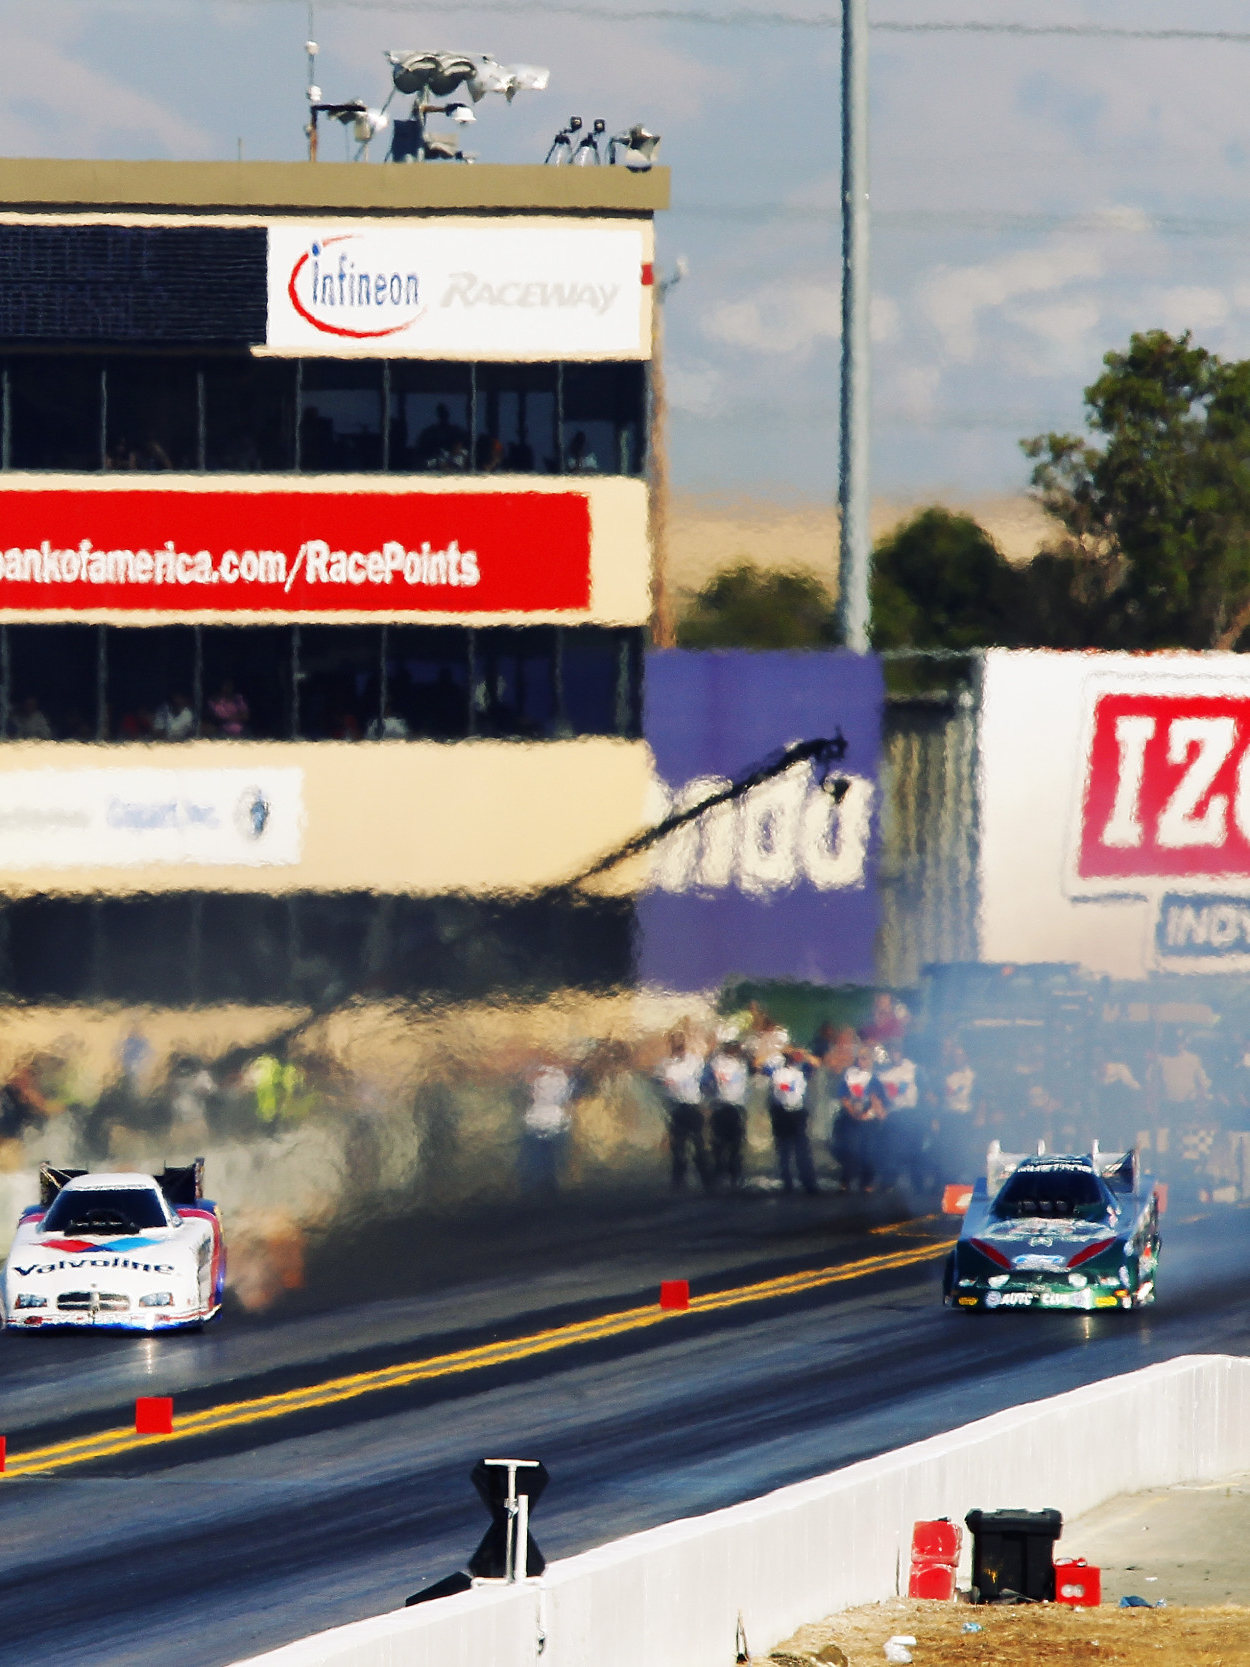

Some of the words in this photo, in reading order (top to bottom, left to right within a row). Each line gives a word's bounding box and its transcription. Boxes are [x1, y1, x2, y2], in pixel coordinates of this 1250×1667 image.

[311, 242, 419, 306] Infineon
[1099, 715, 1250, 848] IZ
[1166, 903, 1250, 948] IND
[13, 1257, 175, 1276] Valvoline
